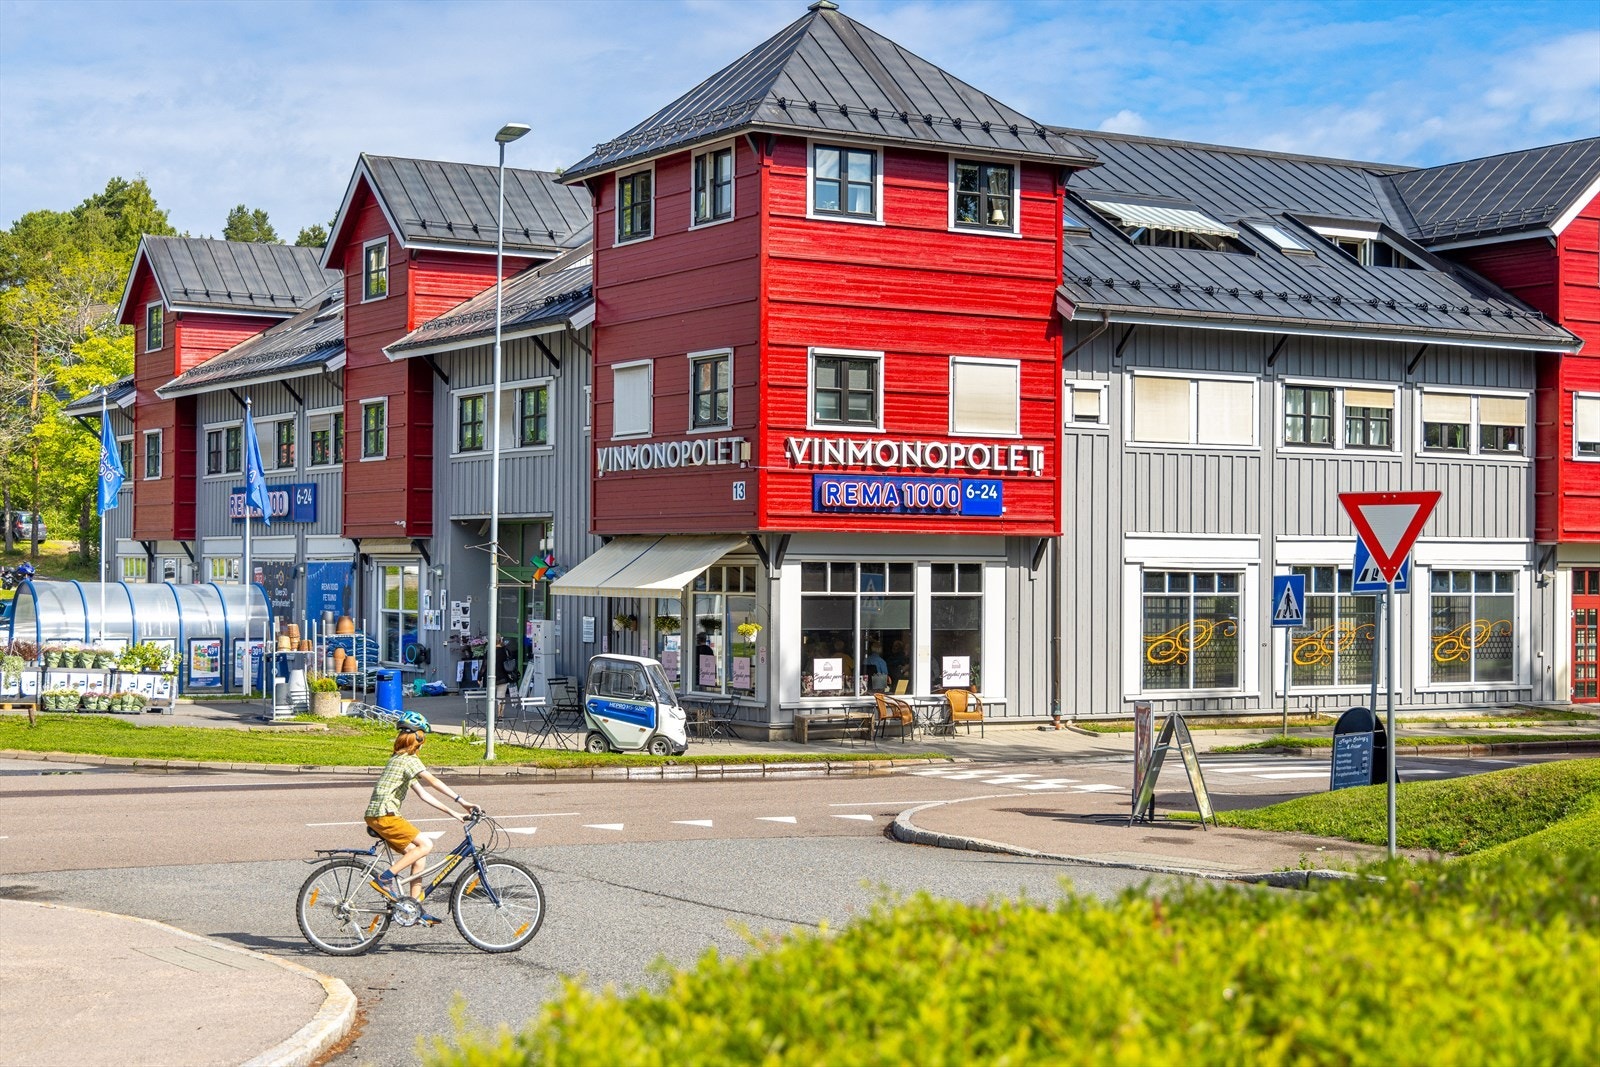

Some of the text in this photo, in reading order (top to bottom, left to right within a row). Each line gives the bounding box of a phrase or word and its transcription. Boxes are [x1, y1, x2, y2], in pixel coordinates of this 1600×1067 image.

[597, 437, 744, 471] VINMONOPOLET
[789, 437, 1044, 471] VINMONOPOLET
[296, 488, 312, 505] 6-24
[733, 482, 745, 499] 13
[823, 481, 961, 509] REMA 1000
[966, 484, 998, 500] 6-24
[432, 855, 463, 887] MERIDA
